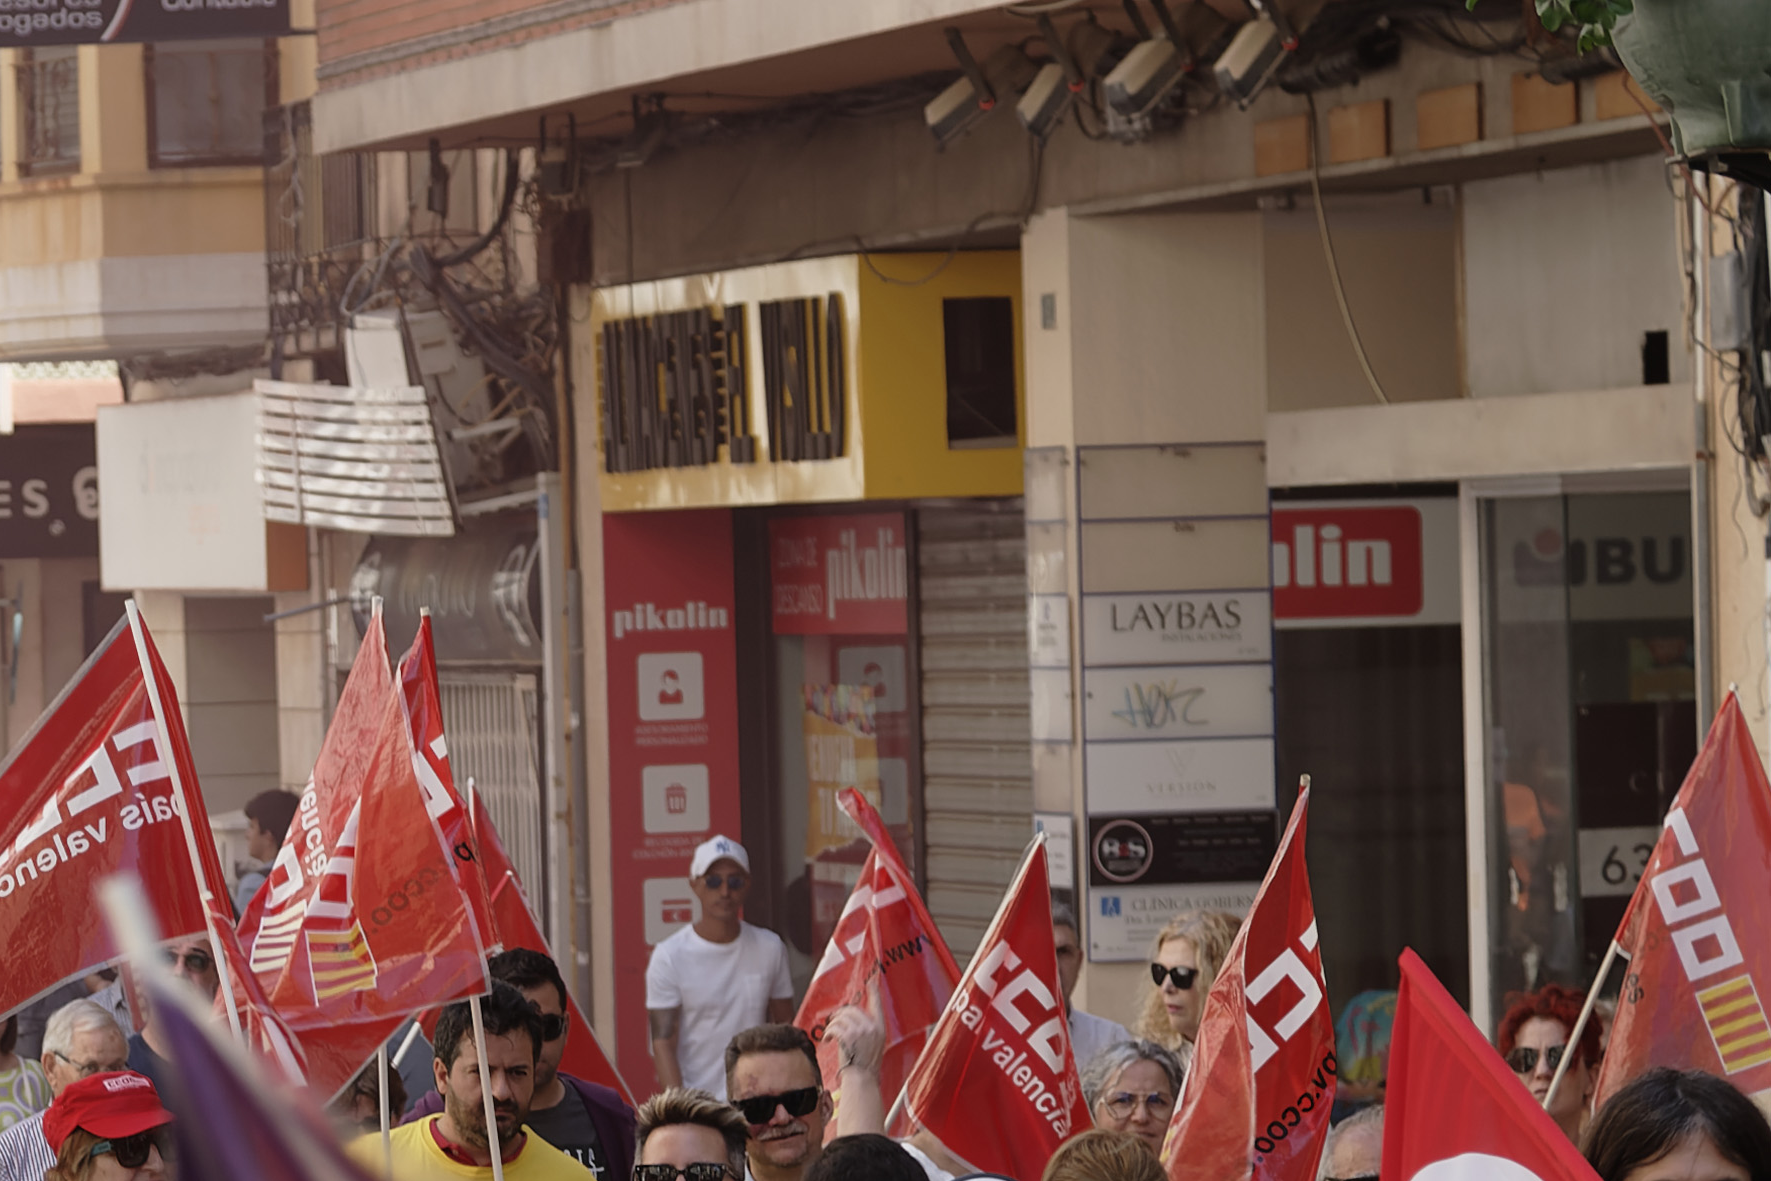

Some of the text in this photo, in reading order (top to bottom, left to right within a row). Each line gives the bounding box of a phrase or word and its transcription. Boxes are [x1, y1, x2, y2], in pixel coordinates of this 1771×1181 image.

[613, 600, 728, 639] pikolin
[1111, 600, 1242, 632] LAYBAS
[1602, 844, 1653, 884] 63
